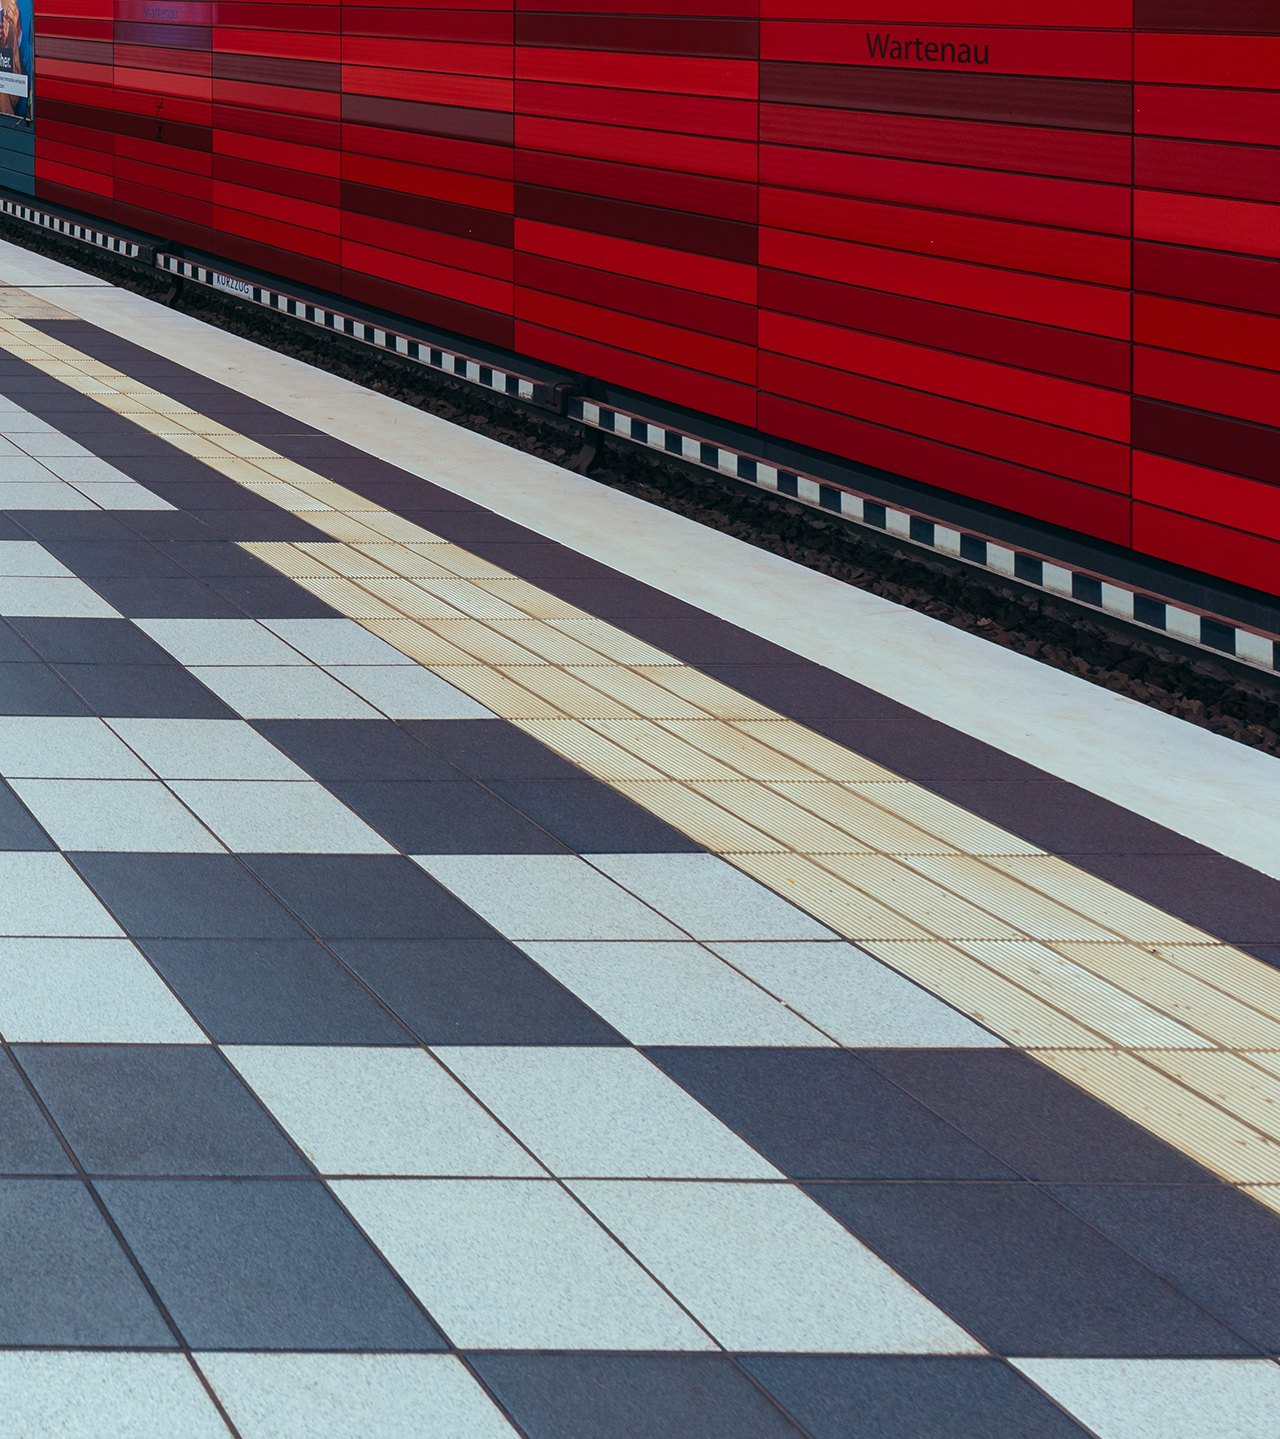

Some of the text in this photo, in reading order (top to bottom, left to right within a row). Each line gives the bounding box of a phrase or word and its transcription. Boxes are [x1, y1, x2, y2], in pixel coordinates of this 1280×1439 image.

[144, 4, 178, 20] Wartenau
[865, 32, 989, 64] Wartenau
[216, 274, 250, 294] KURZZUG
